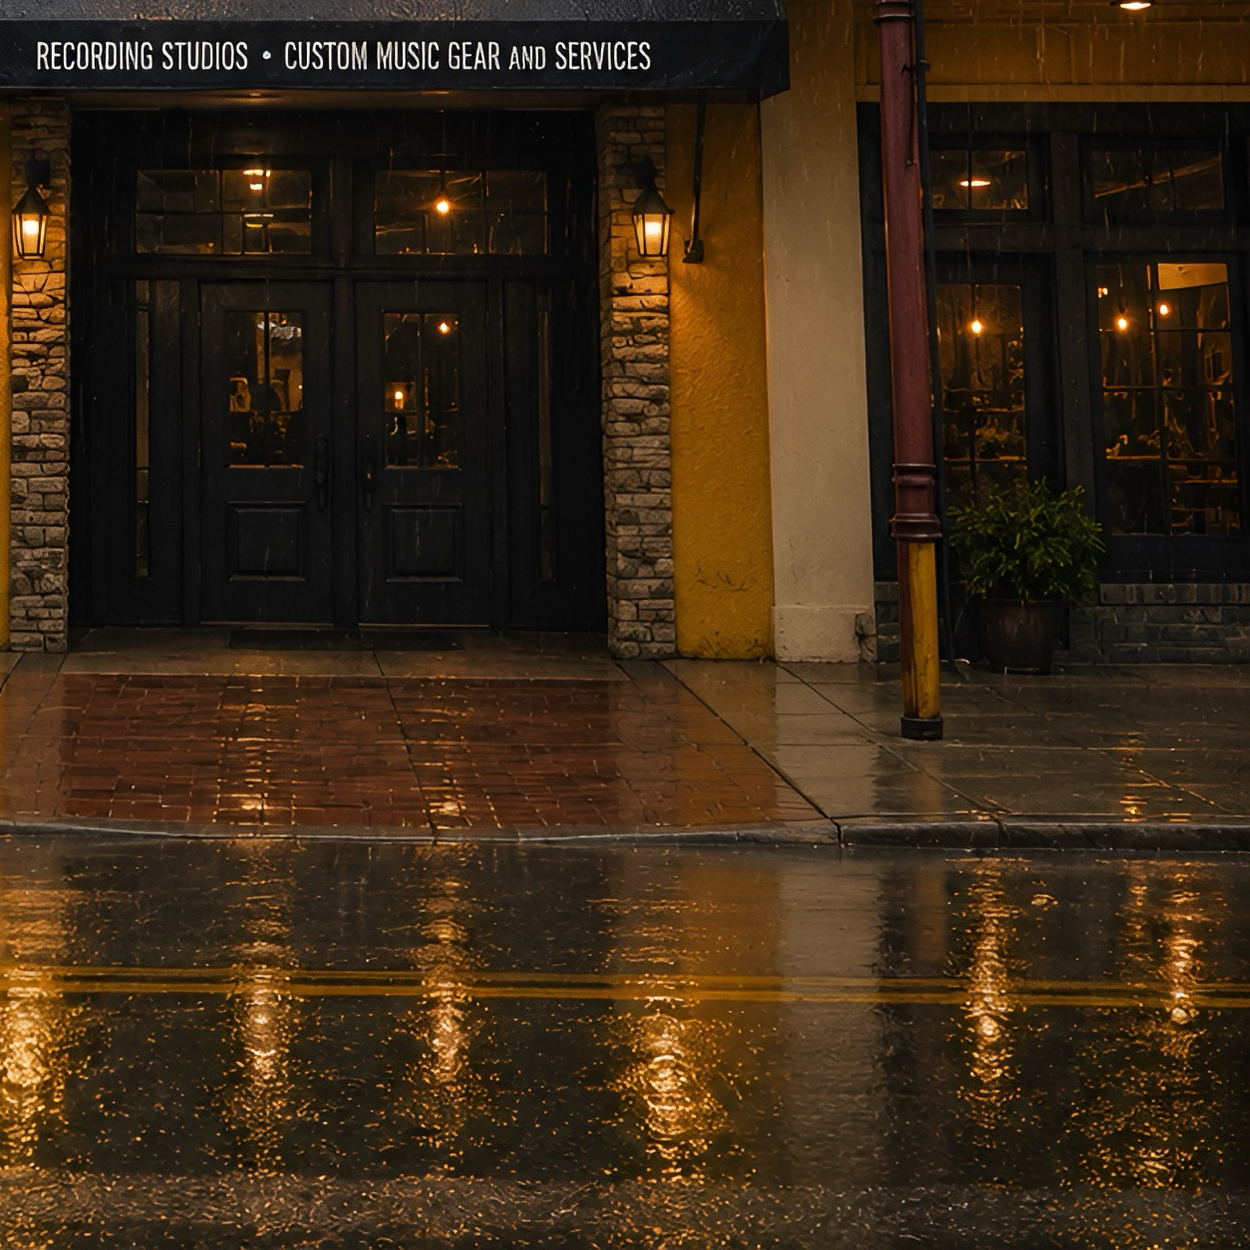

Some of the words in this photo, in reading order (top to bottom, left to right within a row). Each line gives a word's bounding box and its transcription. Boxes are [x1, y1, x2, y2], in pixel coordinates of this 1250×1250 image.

[36, 41, 154, 71] RECORDING
[161, 41, 249, 71] STUDIOS
[284, 41, 368, 71] CUSTOM
[376, 41, 440, 71] MUSIC
[448, 41, 501, 71] GEAR
[508, 45, 546, 71] AND
[555, 41, 651, 71] SERVICES
